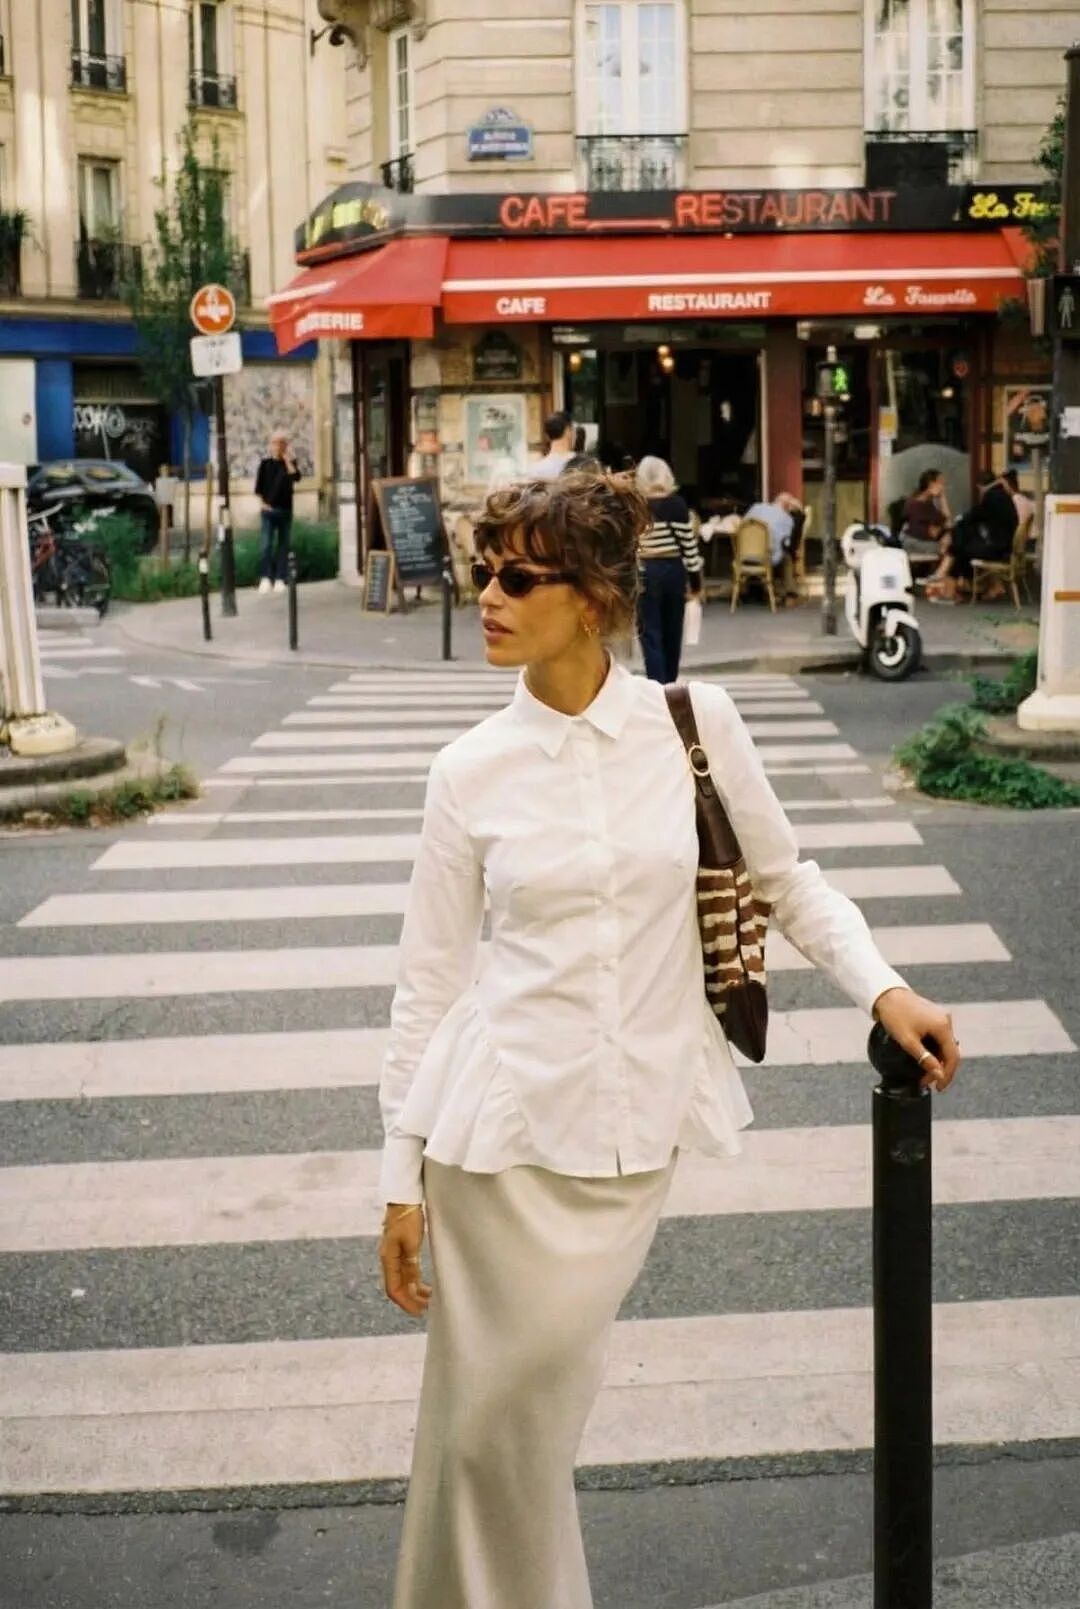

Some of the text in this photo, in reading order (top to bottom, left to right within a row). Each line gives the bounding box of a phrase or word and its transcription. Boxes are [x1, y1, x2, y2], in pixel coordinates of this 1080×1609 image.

[500, 190, 897, 230] CAFE RESTAURANT
[968, 192, 1010, 218] La
[496, 296, 547, 315] CAFE
[648, 291, 772, 312] RESTAURANT
[863, 285, 896, 306] La
